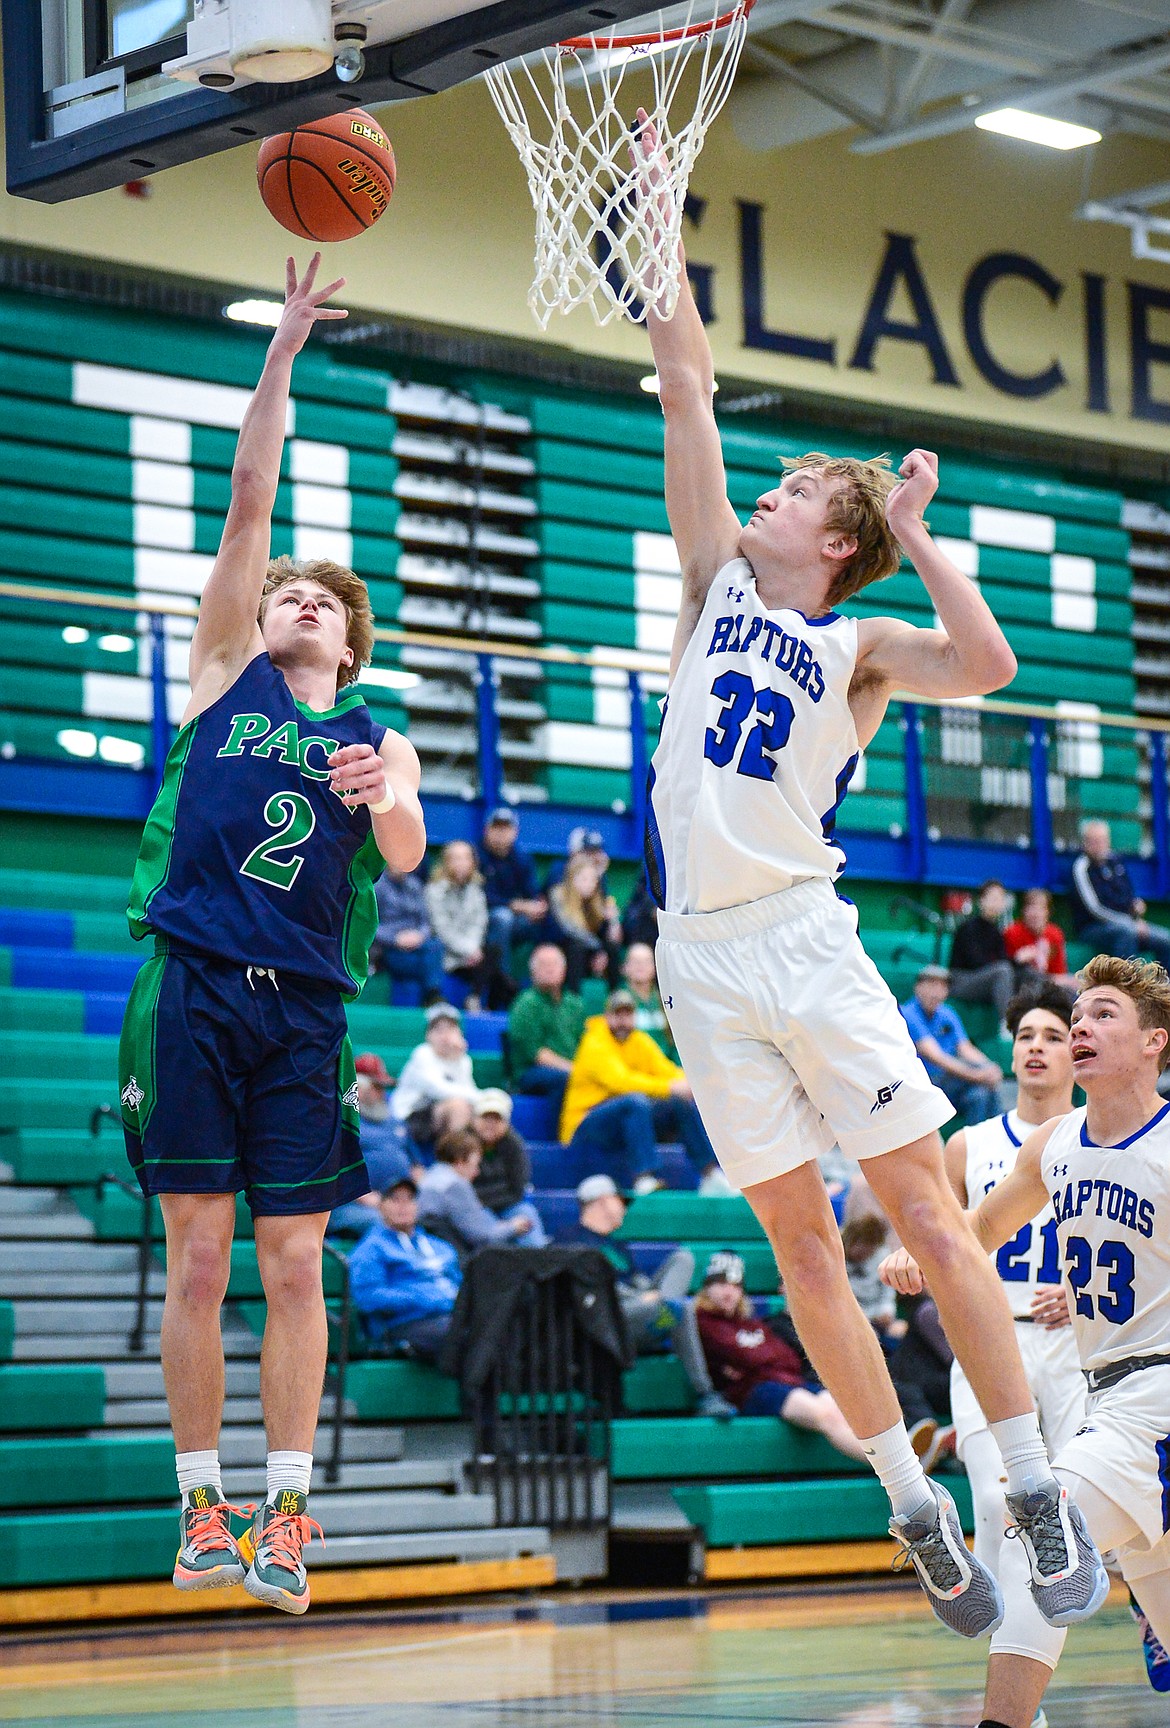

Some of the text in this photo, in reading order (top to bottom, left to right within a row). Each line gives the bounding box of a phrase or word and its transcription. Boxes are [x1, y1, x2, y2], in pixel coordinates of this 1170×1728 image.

[706, 613, 826, 703] RAPTORS
[703, 669, 796, 782] 32
[239, 791, 316, 891] 2
[996, 1217, 1062, 1285] 21
[1052, 1179, 1155, 1239] RAPTORS
[1065, 1236, 1136, 1325] 23
